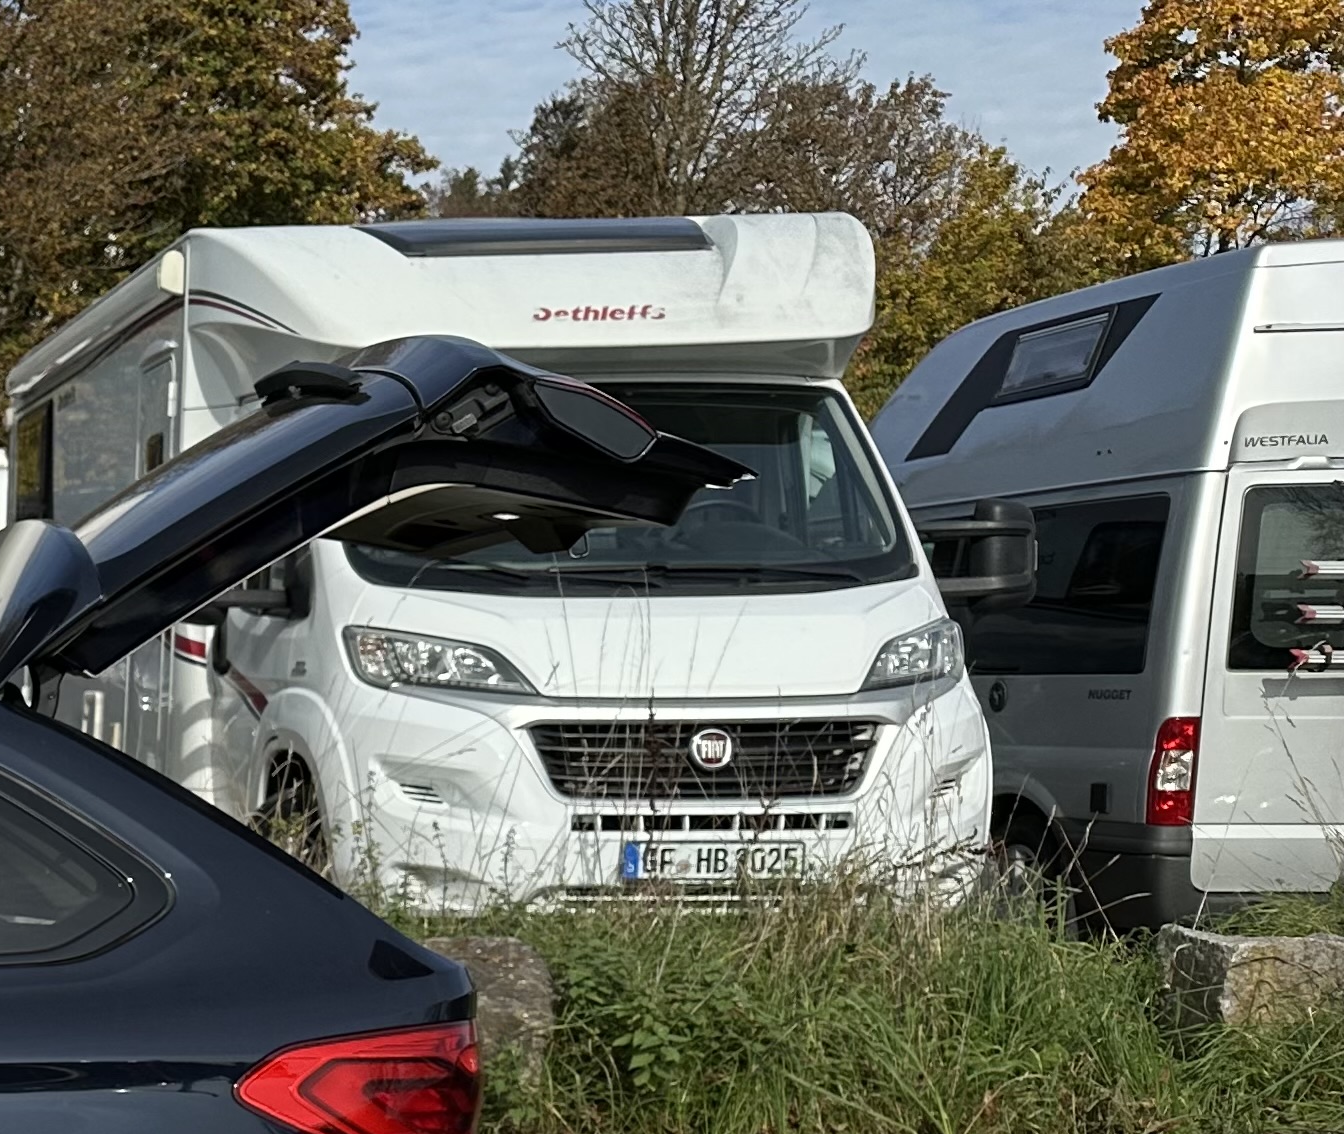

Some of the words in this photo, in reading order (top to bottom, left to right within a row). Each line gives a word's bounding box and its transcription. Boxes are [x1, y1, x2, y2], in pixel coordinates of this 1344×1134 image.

[1244, 434, 1329, 447] WESTFALIA
[1087, 689, 1133, 701] NUGGET
[697, 738, 726, 760] FIAT
[696, 848, 729, 874] HB
